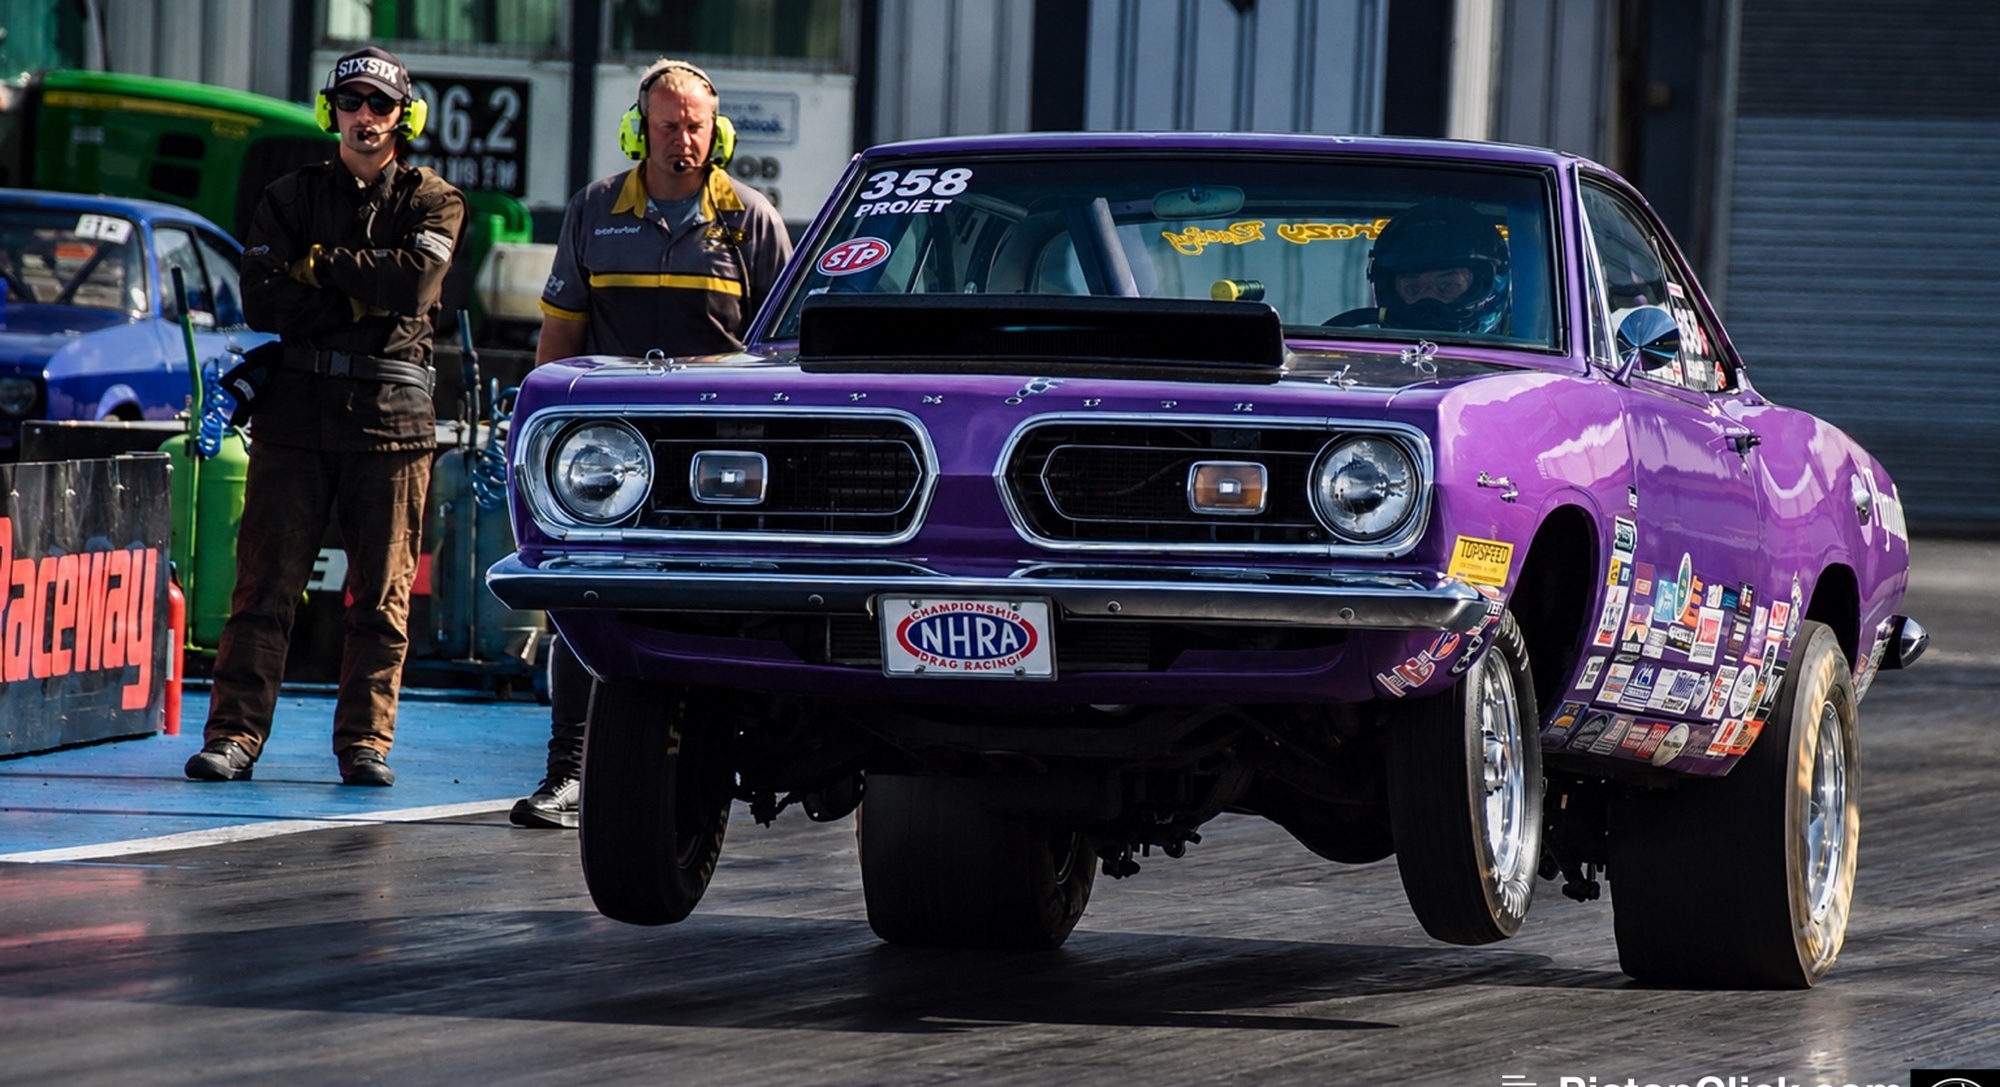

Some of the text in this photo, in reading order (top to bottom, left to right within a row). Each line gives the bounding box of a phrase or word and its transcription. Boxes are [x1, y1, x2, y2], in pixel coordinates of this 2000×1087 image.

[338, 58, 399, 84] SIXSIX
[860, 168, 973, 200] 358
[854, 199, 953, 218] PRO/ET
[824, 242, 880, 269] STP
[1459, 538, 1509, 565] TOPSPEED
[911, 602, 1021, 622] CHAMPIONSHIP
[920, 616, 1020, 657] NHRA
[919, 651, 958, 669] DRAG
